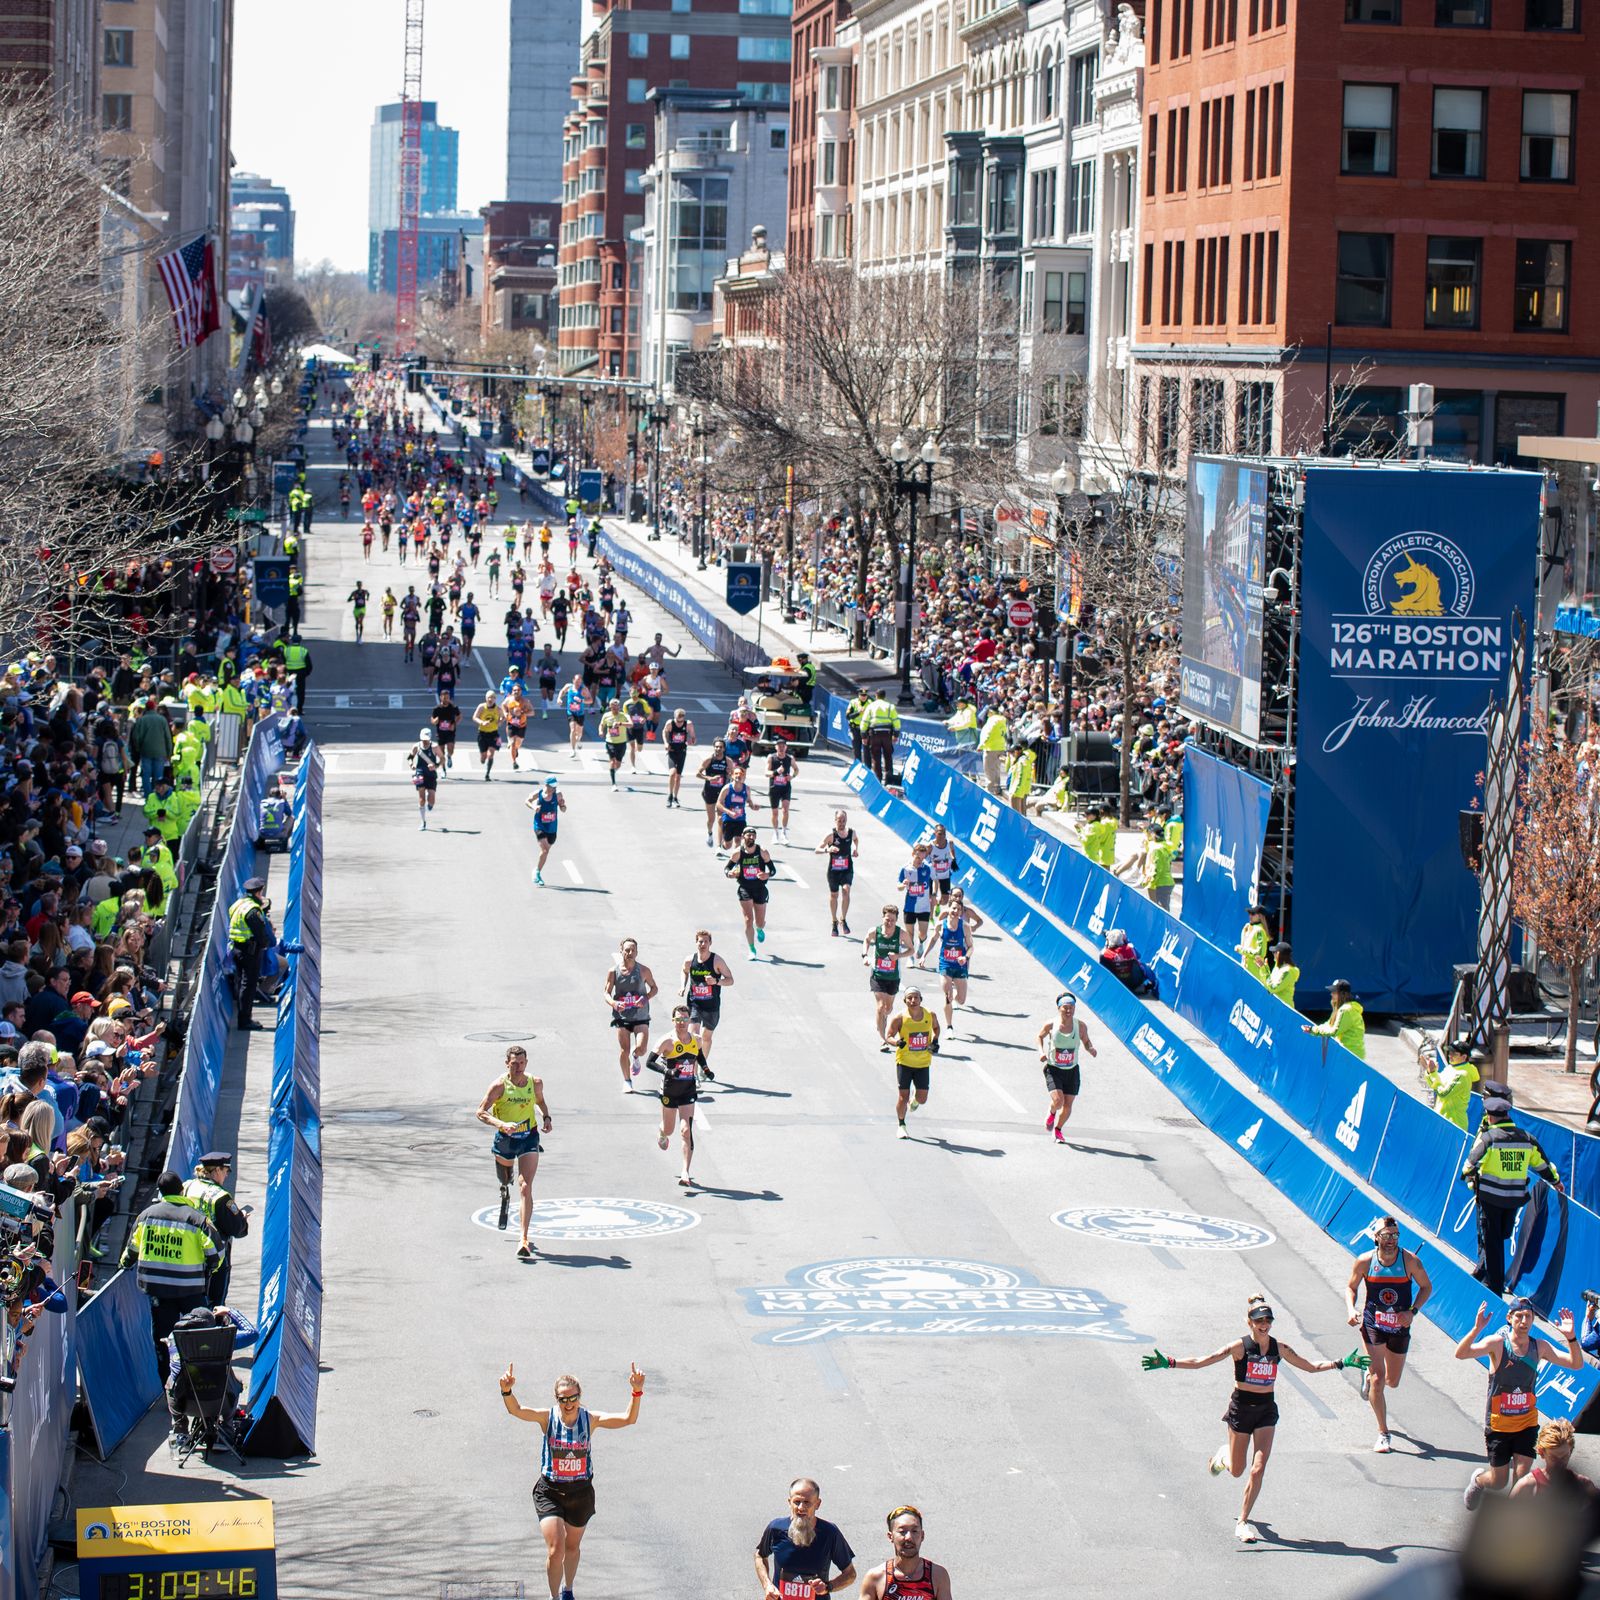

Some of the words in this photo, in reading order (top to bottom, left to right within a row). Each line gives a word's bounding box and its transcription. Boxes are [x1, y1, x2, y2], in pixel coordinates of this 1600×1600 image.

[1368, 560, 1383, 610] BOSTON
[1381, 536, 1433, 561] ATHLETIC
[1433, 541, 1470, 612] ASSOCIATION
[1331, 623, 1391, 643] 126TH
[1394, 625, 1501, 646] BOSTON
[1330, 648, 1501, 672] MARATHON
[1322, 695, 1394, 753] John
[1394, 694, 1490, 736] Hancock
[900, 739, 945, 752] MATHON
[901, 731, 914, 740] THE
[915, 734, 945, 746] BOSTON
[1500, 1151, 1525, 1161] BOSTON
[1502, 1162, 1522, 1172] POLICE
[146, 1229, 183, 1246] Boston
[145, 1242, 182, 1260] Police
[756, 1291, 871, 1301] 126TH
[879, 1291, 1093, 1303] BOSTON
[761, 1300, 1103, 1312] MARATHON
[772, 1318, 910, 1342] John
[909, 1318, 1137, 1341] Hancock
[1252, 1363, 1273, 1375] 2380
[558, 1459, 581, 1471] 5206
[112, 1521, 139, 1530] 126TH
[141, 1519, 191, 1529] BOSTON
[112, 1528, 192, 1539] MARATHON
[127, 1567, 256, 1600] 3:09:46
[784, 1582, 811, 1599] 6810
